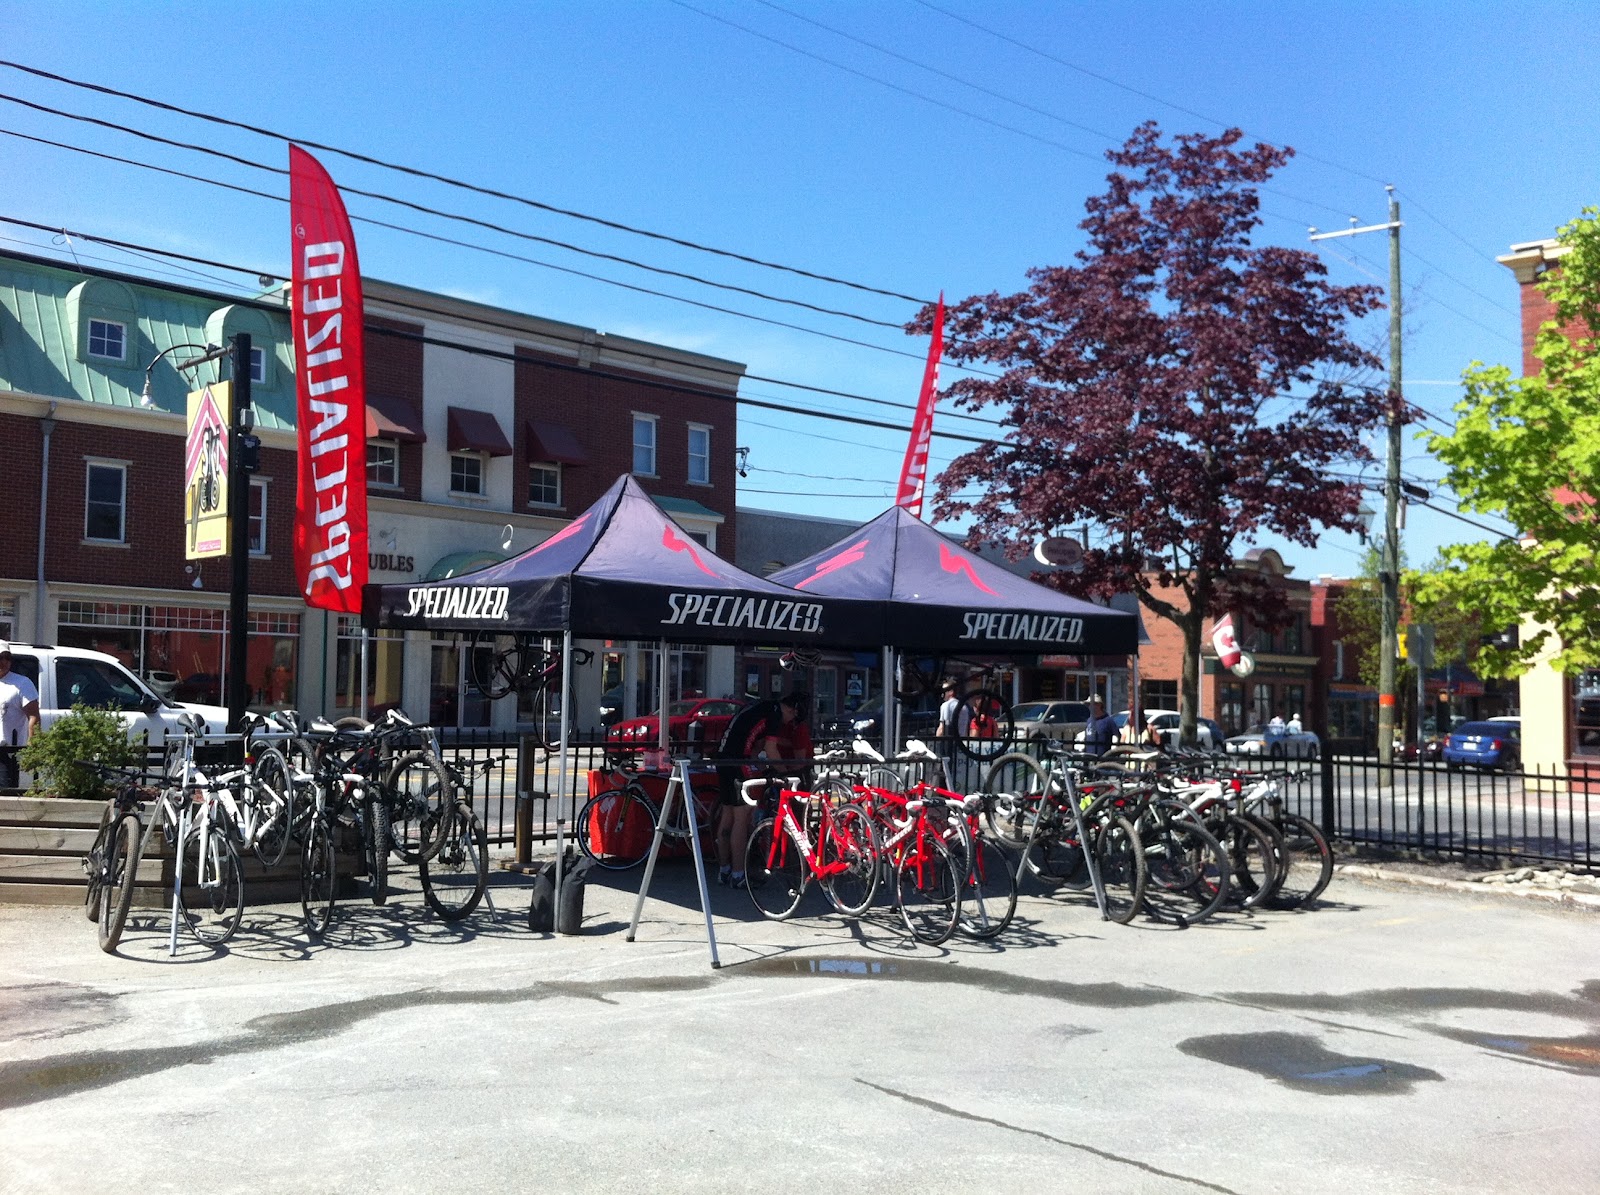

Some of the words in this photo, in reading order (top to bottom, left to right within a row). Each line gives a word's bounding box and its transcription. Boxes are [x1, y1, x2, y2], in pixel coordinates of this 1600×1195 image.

[403, 586, 510, 619] SPECIALIZED
[660, 592, 824, 633] SPECIALIZED
[959, 612, 1083, 643] SPECIALIZED
